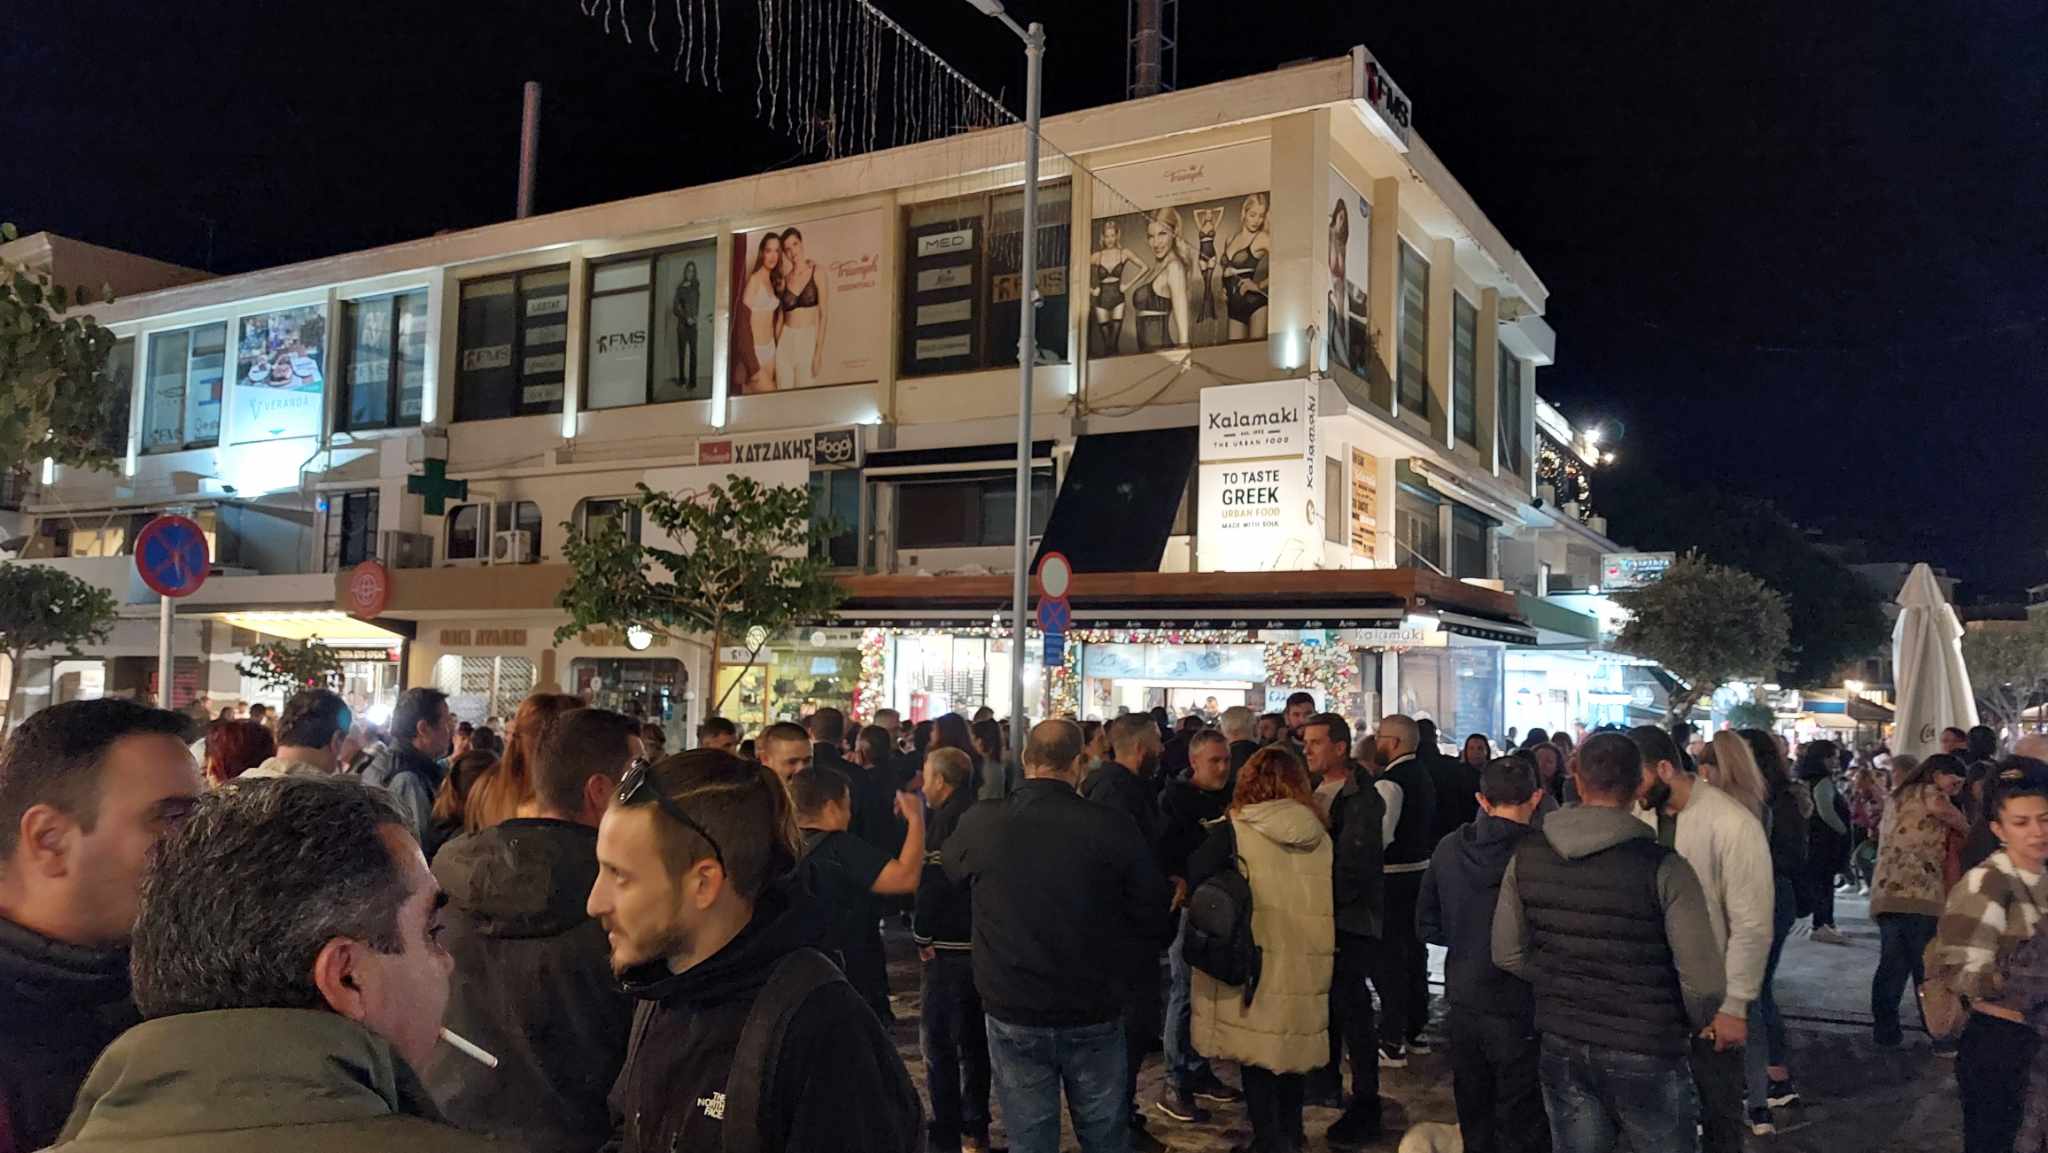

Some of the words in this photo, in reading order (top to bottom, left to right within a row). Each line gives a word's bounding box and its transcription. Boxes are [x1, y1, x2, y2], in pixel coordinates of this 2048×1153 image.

[925, 236, 964, 249] MED
[609, 330, 645, 346] FMS
[264, 398, 309, 411] VERANDA
[1208, 406, 1298, 429] Kalamaki
[1233, 438, 1261, 447] URBAN
[1265, 436, 1289, 445] FOOD
[735, 438, 813, 463] ΧΑΤΖΑΚΗΣ
[1222, 472, 1239, 485] TO
[1241, 470, 1280, 484] TASTE
[1222, 486, 1280, 505] GREEK
[1221, 508, 1253, 519] URBAN
[1255, 506, 1281, 517] FOOD
[1221, 521, 1240, 529] MADE
[697, 1098, 725, 1111] NORTH
[704, 1107, 724, 1120] FACE
